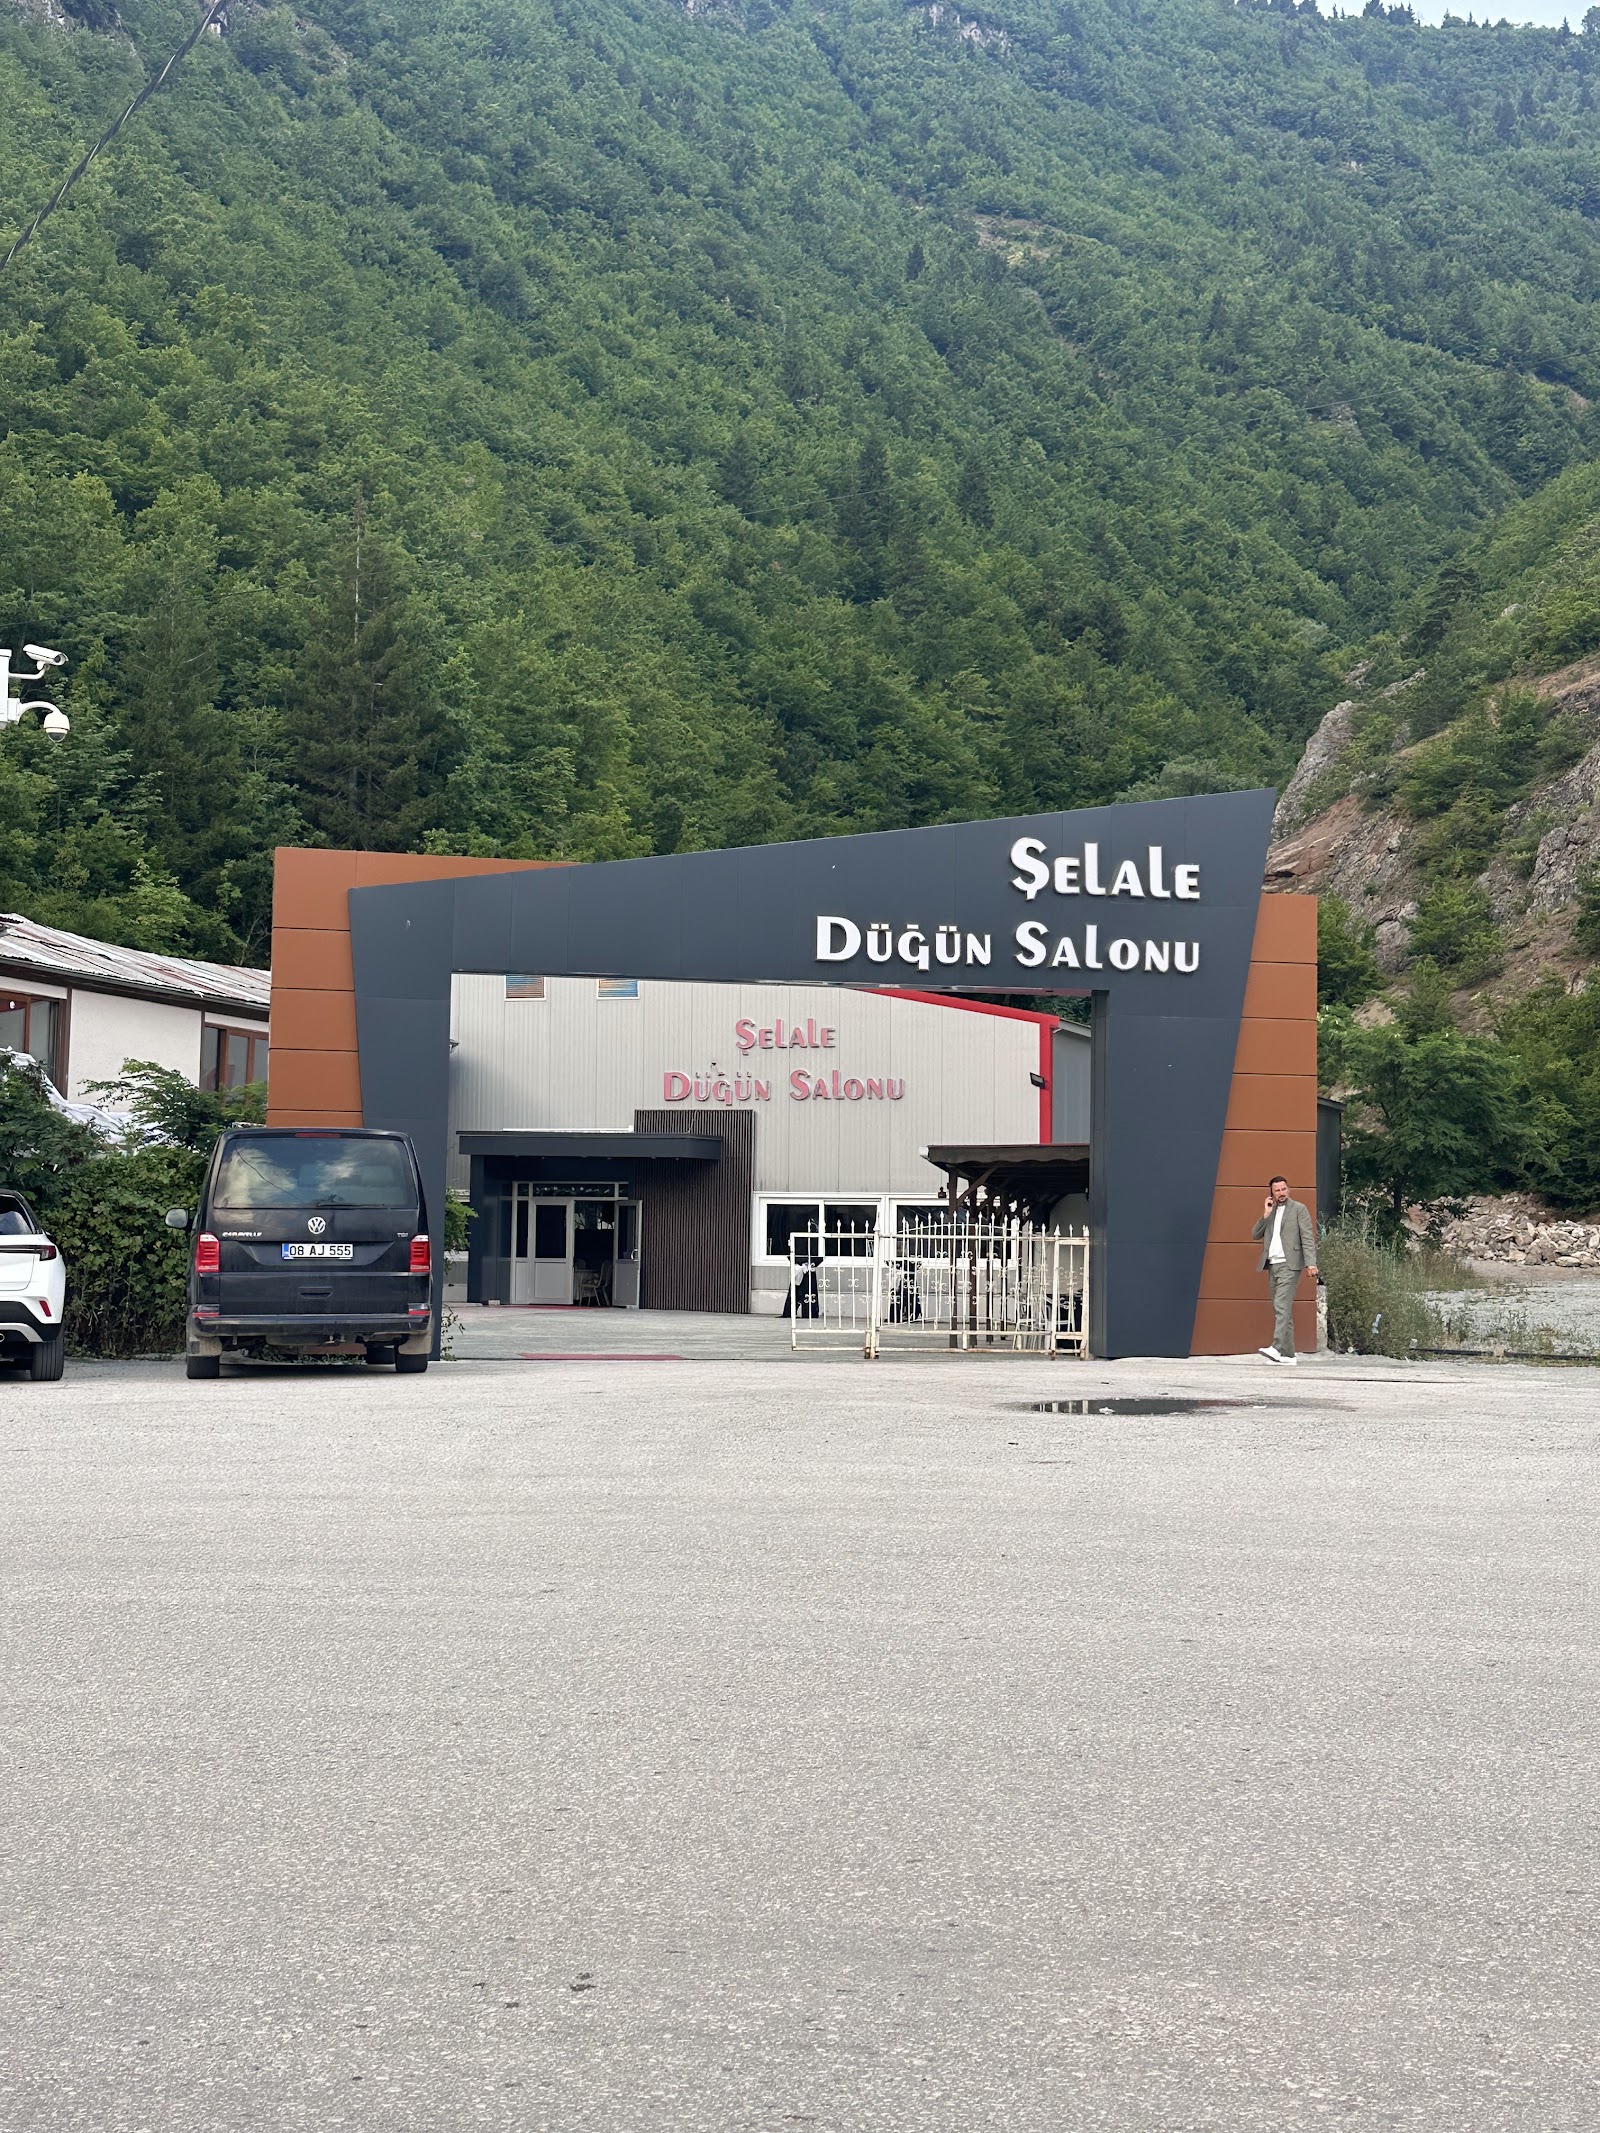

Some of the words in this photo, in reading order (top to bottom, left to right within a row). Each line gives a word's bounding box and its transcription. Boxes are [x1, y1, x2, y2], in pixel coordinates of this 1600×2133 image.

[1015, 920, 1201, 974] SALONU
[789, 1069, 905, 1101] SALONU
[289, 1245, 305, 1256] 08
[309, 1245, 325, 1256] AJ
[329, 1245, 352, 1256] 555
